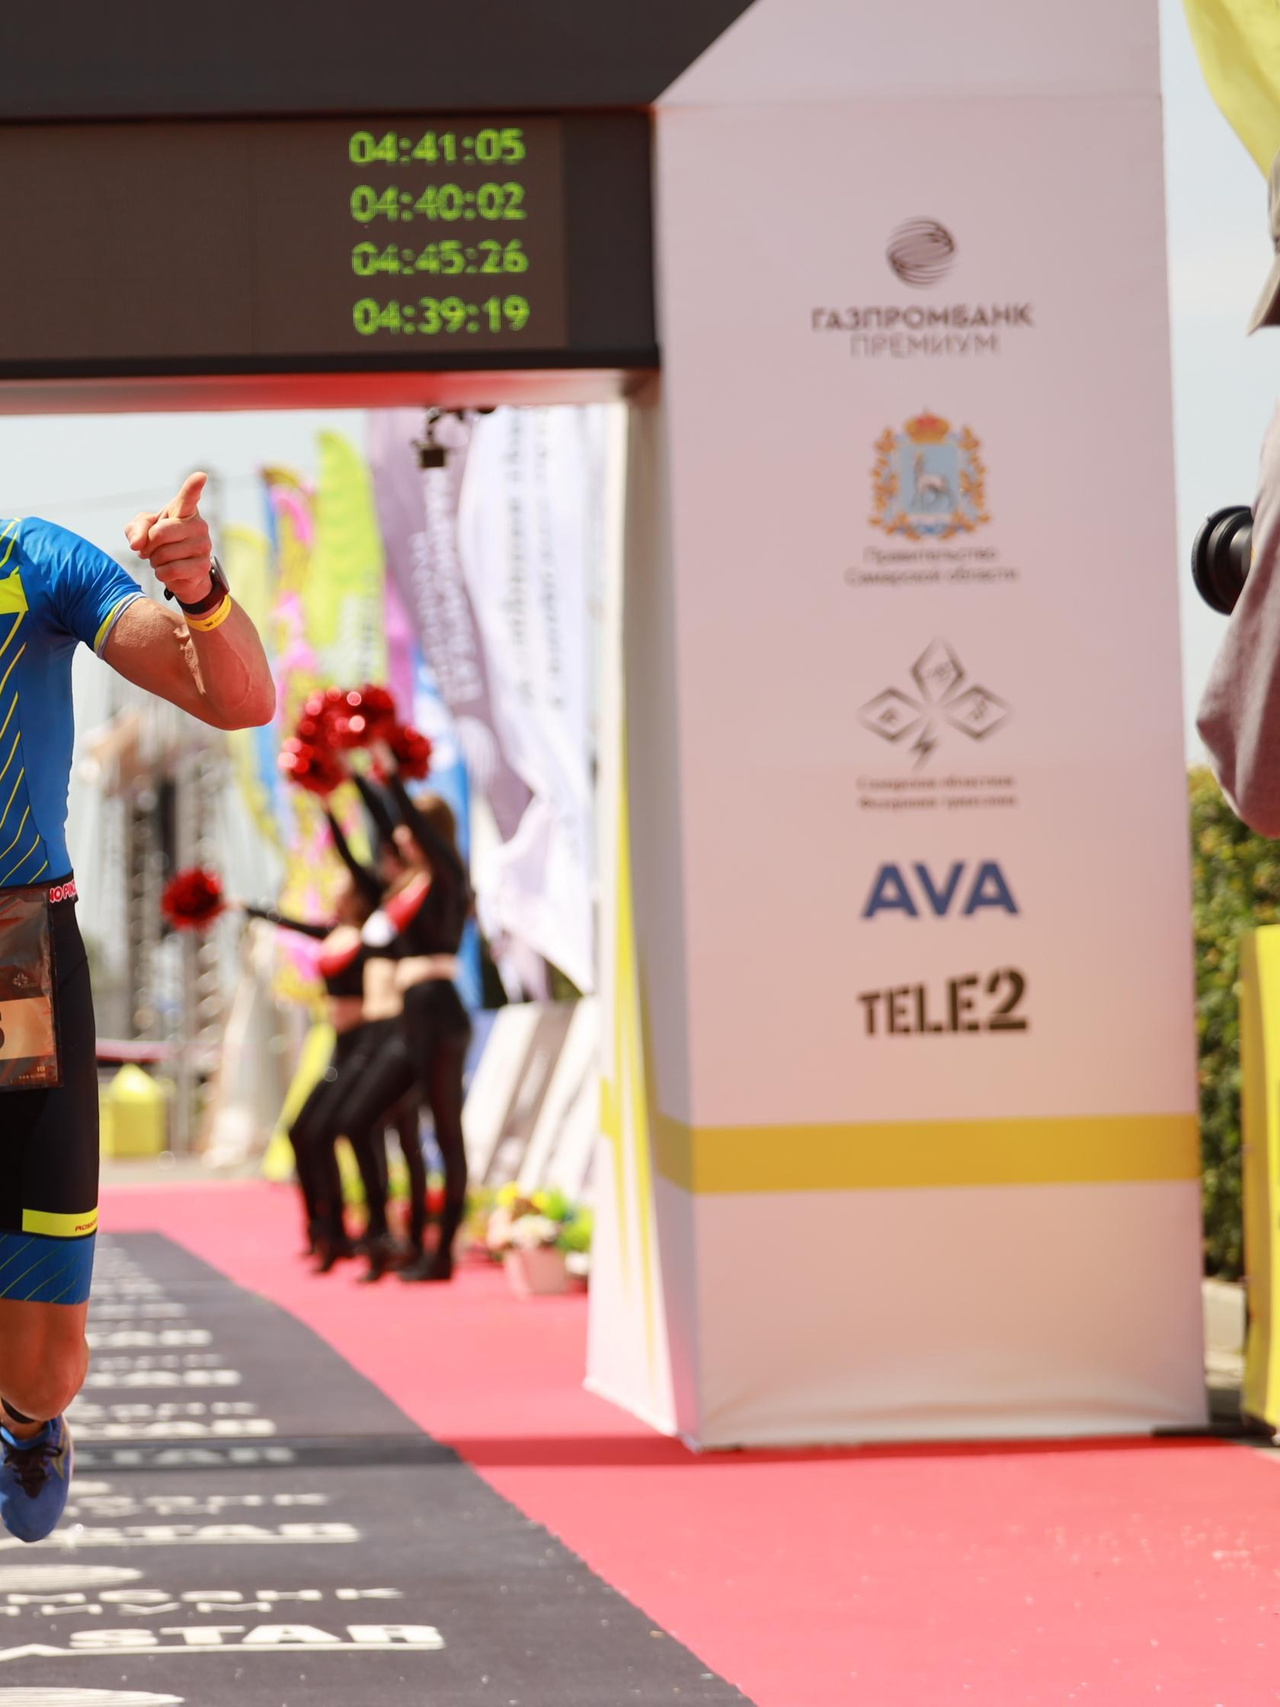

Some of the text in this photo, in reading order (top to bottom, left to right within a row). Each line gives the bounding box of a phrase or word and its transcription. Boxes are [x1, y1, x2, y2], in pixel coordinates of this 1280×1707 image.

[349, 128, 526, 166] 04:41:05
[350, 182, 527, 222] 04:40:02
[351, 239, 529, 276] 04:45:26
[352, 295, 531, 335] 04:39:19
[811, 303, 1034, 331] ГАЗПРОМБАНК
[849, 330, 1000, 359] ПРЕМИУМ
[861, 859, 1020, 920] AVA
[857, 966, 1030, 1038] TELE2
[69, 1624, 444, 1647] STAR
